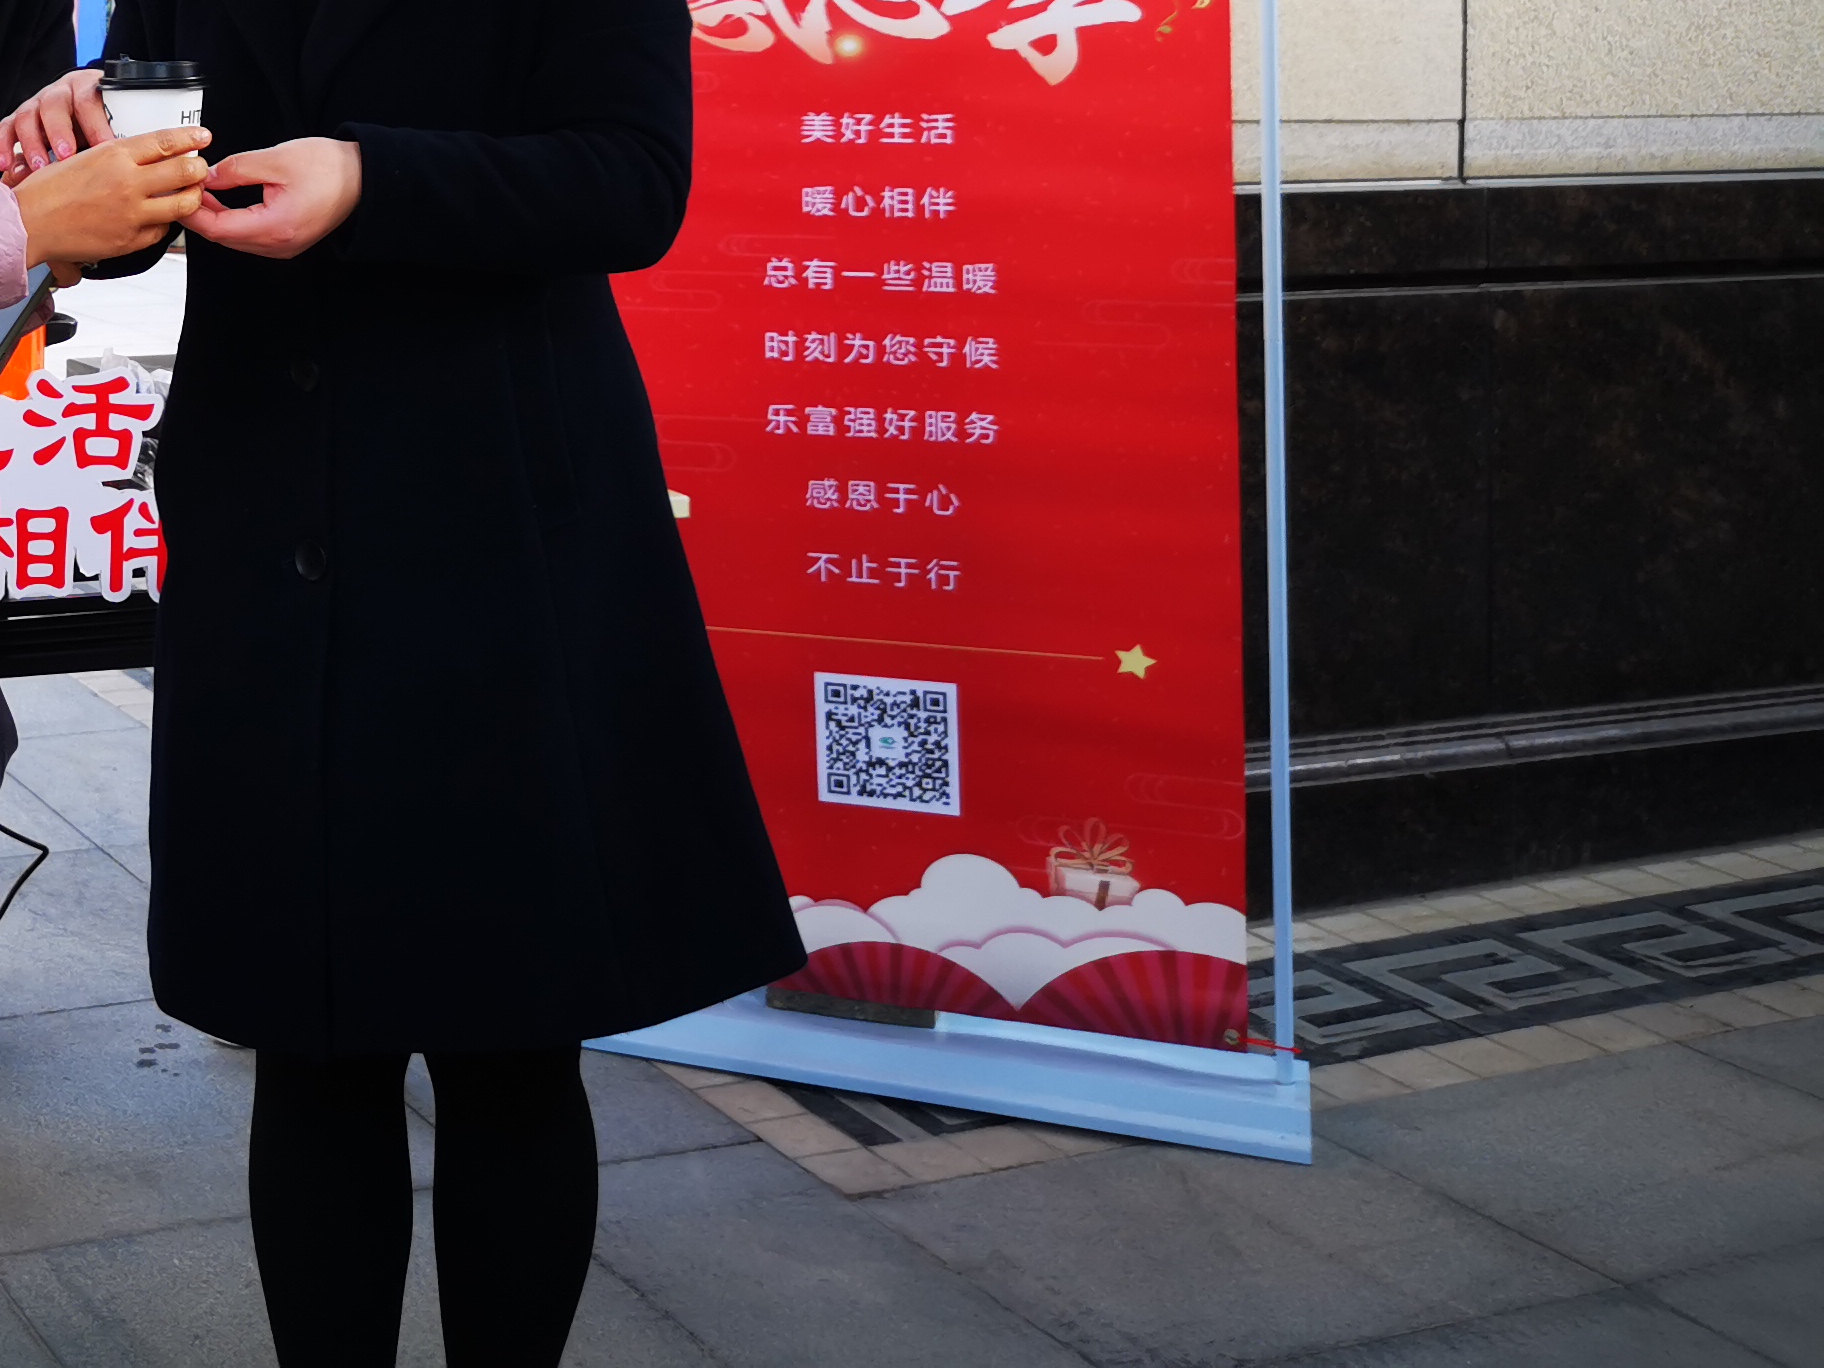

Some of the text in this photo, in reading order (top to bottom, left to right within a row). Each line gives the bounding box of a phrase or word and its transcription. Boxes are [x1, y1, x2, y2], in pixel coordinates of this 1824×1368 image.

[800, 111, 956, 145] 美好生活
[801, 185, 957, 219] 暖心相伴
[763, 257, 999, 294] 总有一些温暖
[764, 330, 1000, 370] 时刻为您守候
[765, 404, 1000, 444] 乐富强好服务
[806, 478, 961, 516] 感恩于心
[806, 552, 961, 591] 不止于行
